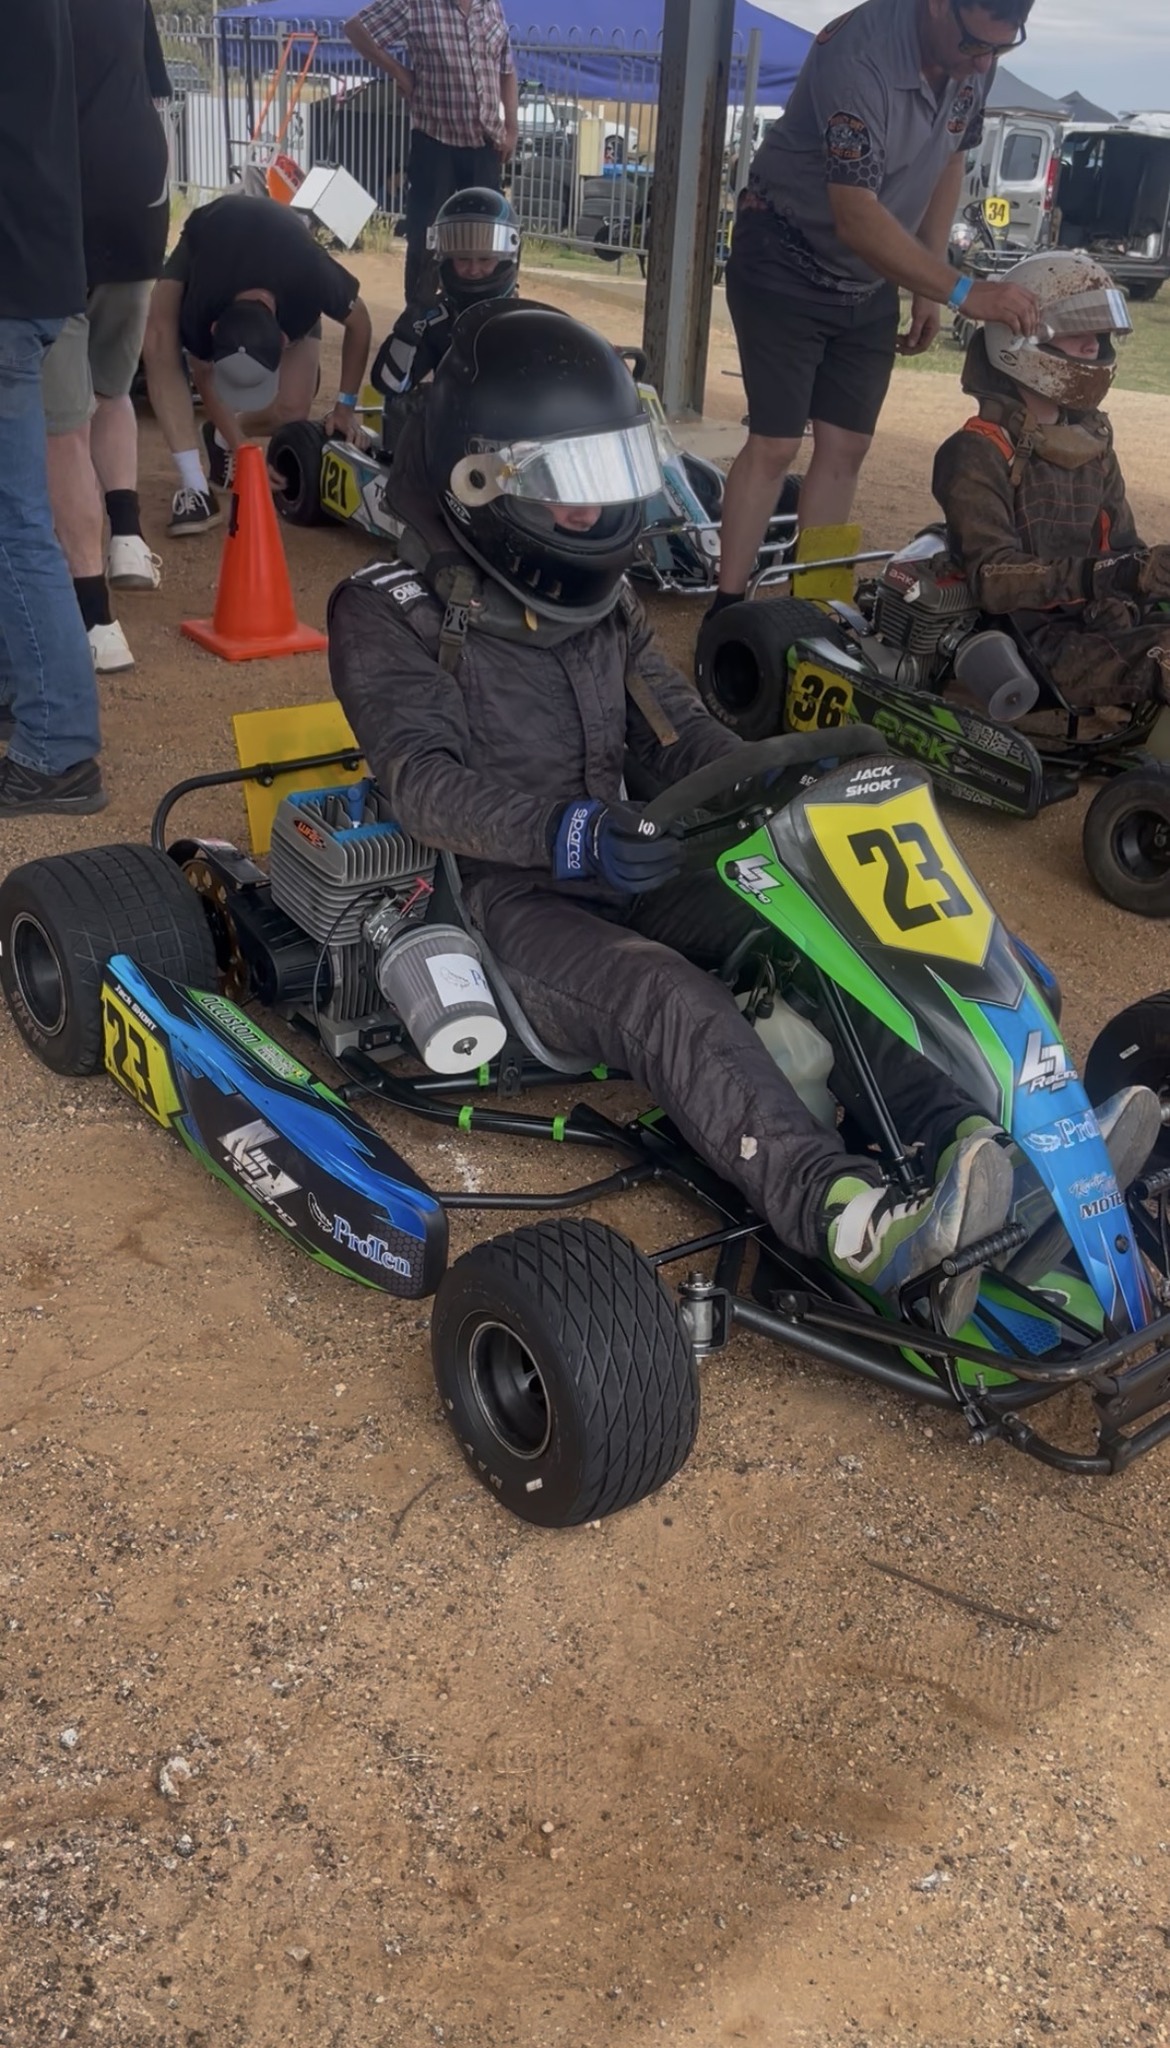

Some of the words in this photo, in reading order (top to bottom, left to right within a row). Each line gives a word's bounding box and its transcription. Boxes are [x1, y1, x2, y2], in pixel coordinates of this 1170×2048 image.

[988, 201, 1006, 222] 34
[322, 455, 348, 511] 121
[793, 674, 848, 729] 36
[845, 777, 902, 798] SHORT
[850, 764, 895, 783] JACK
[847, 822, 974, 932] 23
[131, 1004, 158, 1032] SHORT
[200, 995, 262, 1046] accustom
[106, 997, 161, 1116] 23
[1028, 1069, 1079, 1094] Racing
[333, 1213, 413, 1278] ProTen
